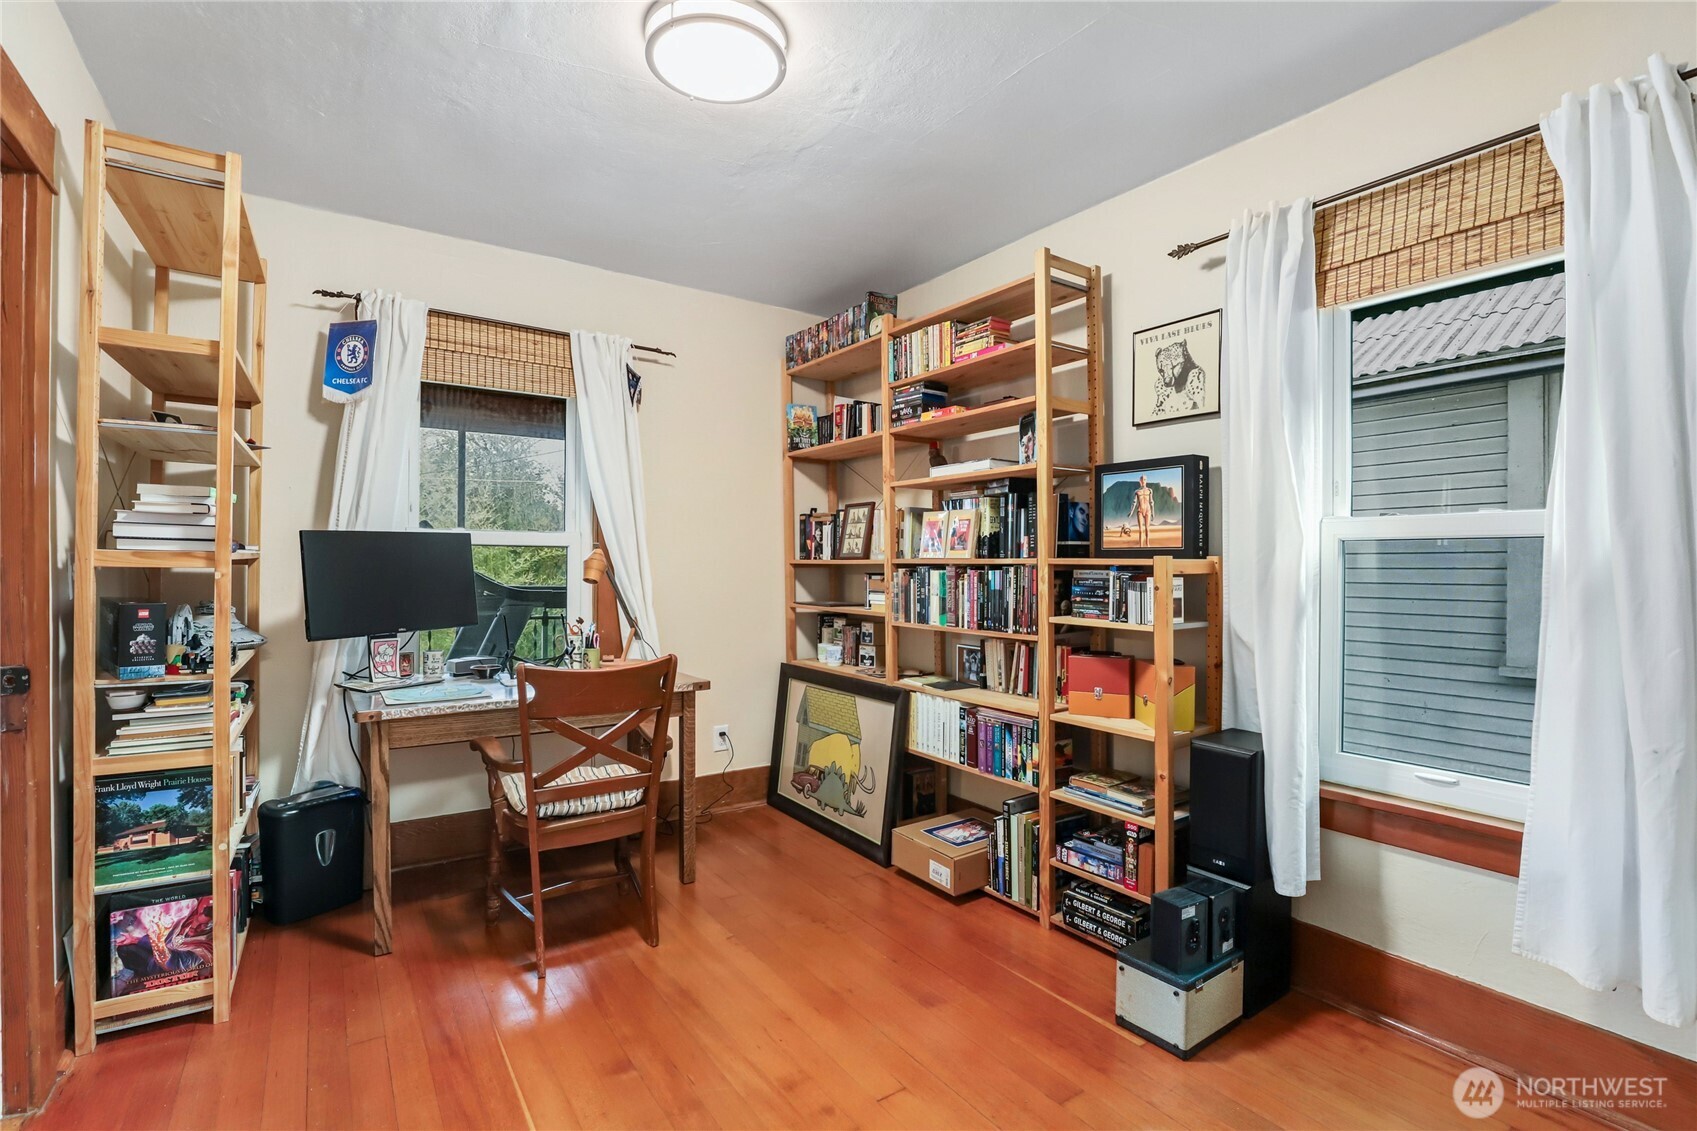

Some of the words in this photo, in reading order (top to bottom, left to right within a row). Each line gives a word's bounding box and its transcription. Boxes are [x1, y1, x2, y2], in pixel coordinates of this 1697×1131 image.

[341, 336, 364, 344] CHELSEA
[1140, 335, 1158, 345] VIVA
[1161, 329, 1181, 340] LAST
[1184, 321, 1213, 334] BLUES
[94, 784, 115, 793] Frank
[116, 781, 137, 792] Lloyd
[137, 779, 161, 790] Wright
[163, 777, 186, 786] Prairie
[187, 776, 212, 784] Houses
[1072, 899, 1096, 915] GILBERT
[1102, 912, 1126, 928] GEORGE
[1073, 916, 1097, 931] GILBERT
[1097, 927, 1102, 935] &
[1103, 930, 1127, 946] GEORGE
[141, 969, 181, 982] MYSTERIOUS
[181, 963, 205, 973] WORLD
